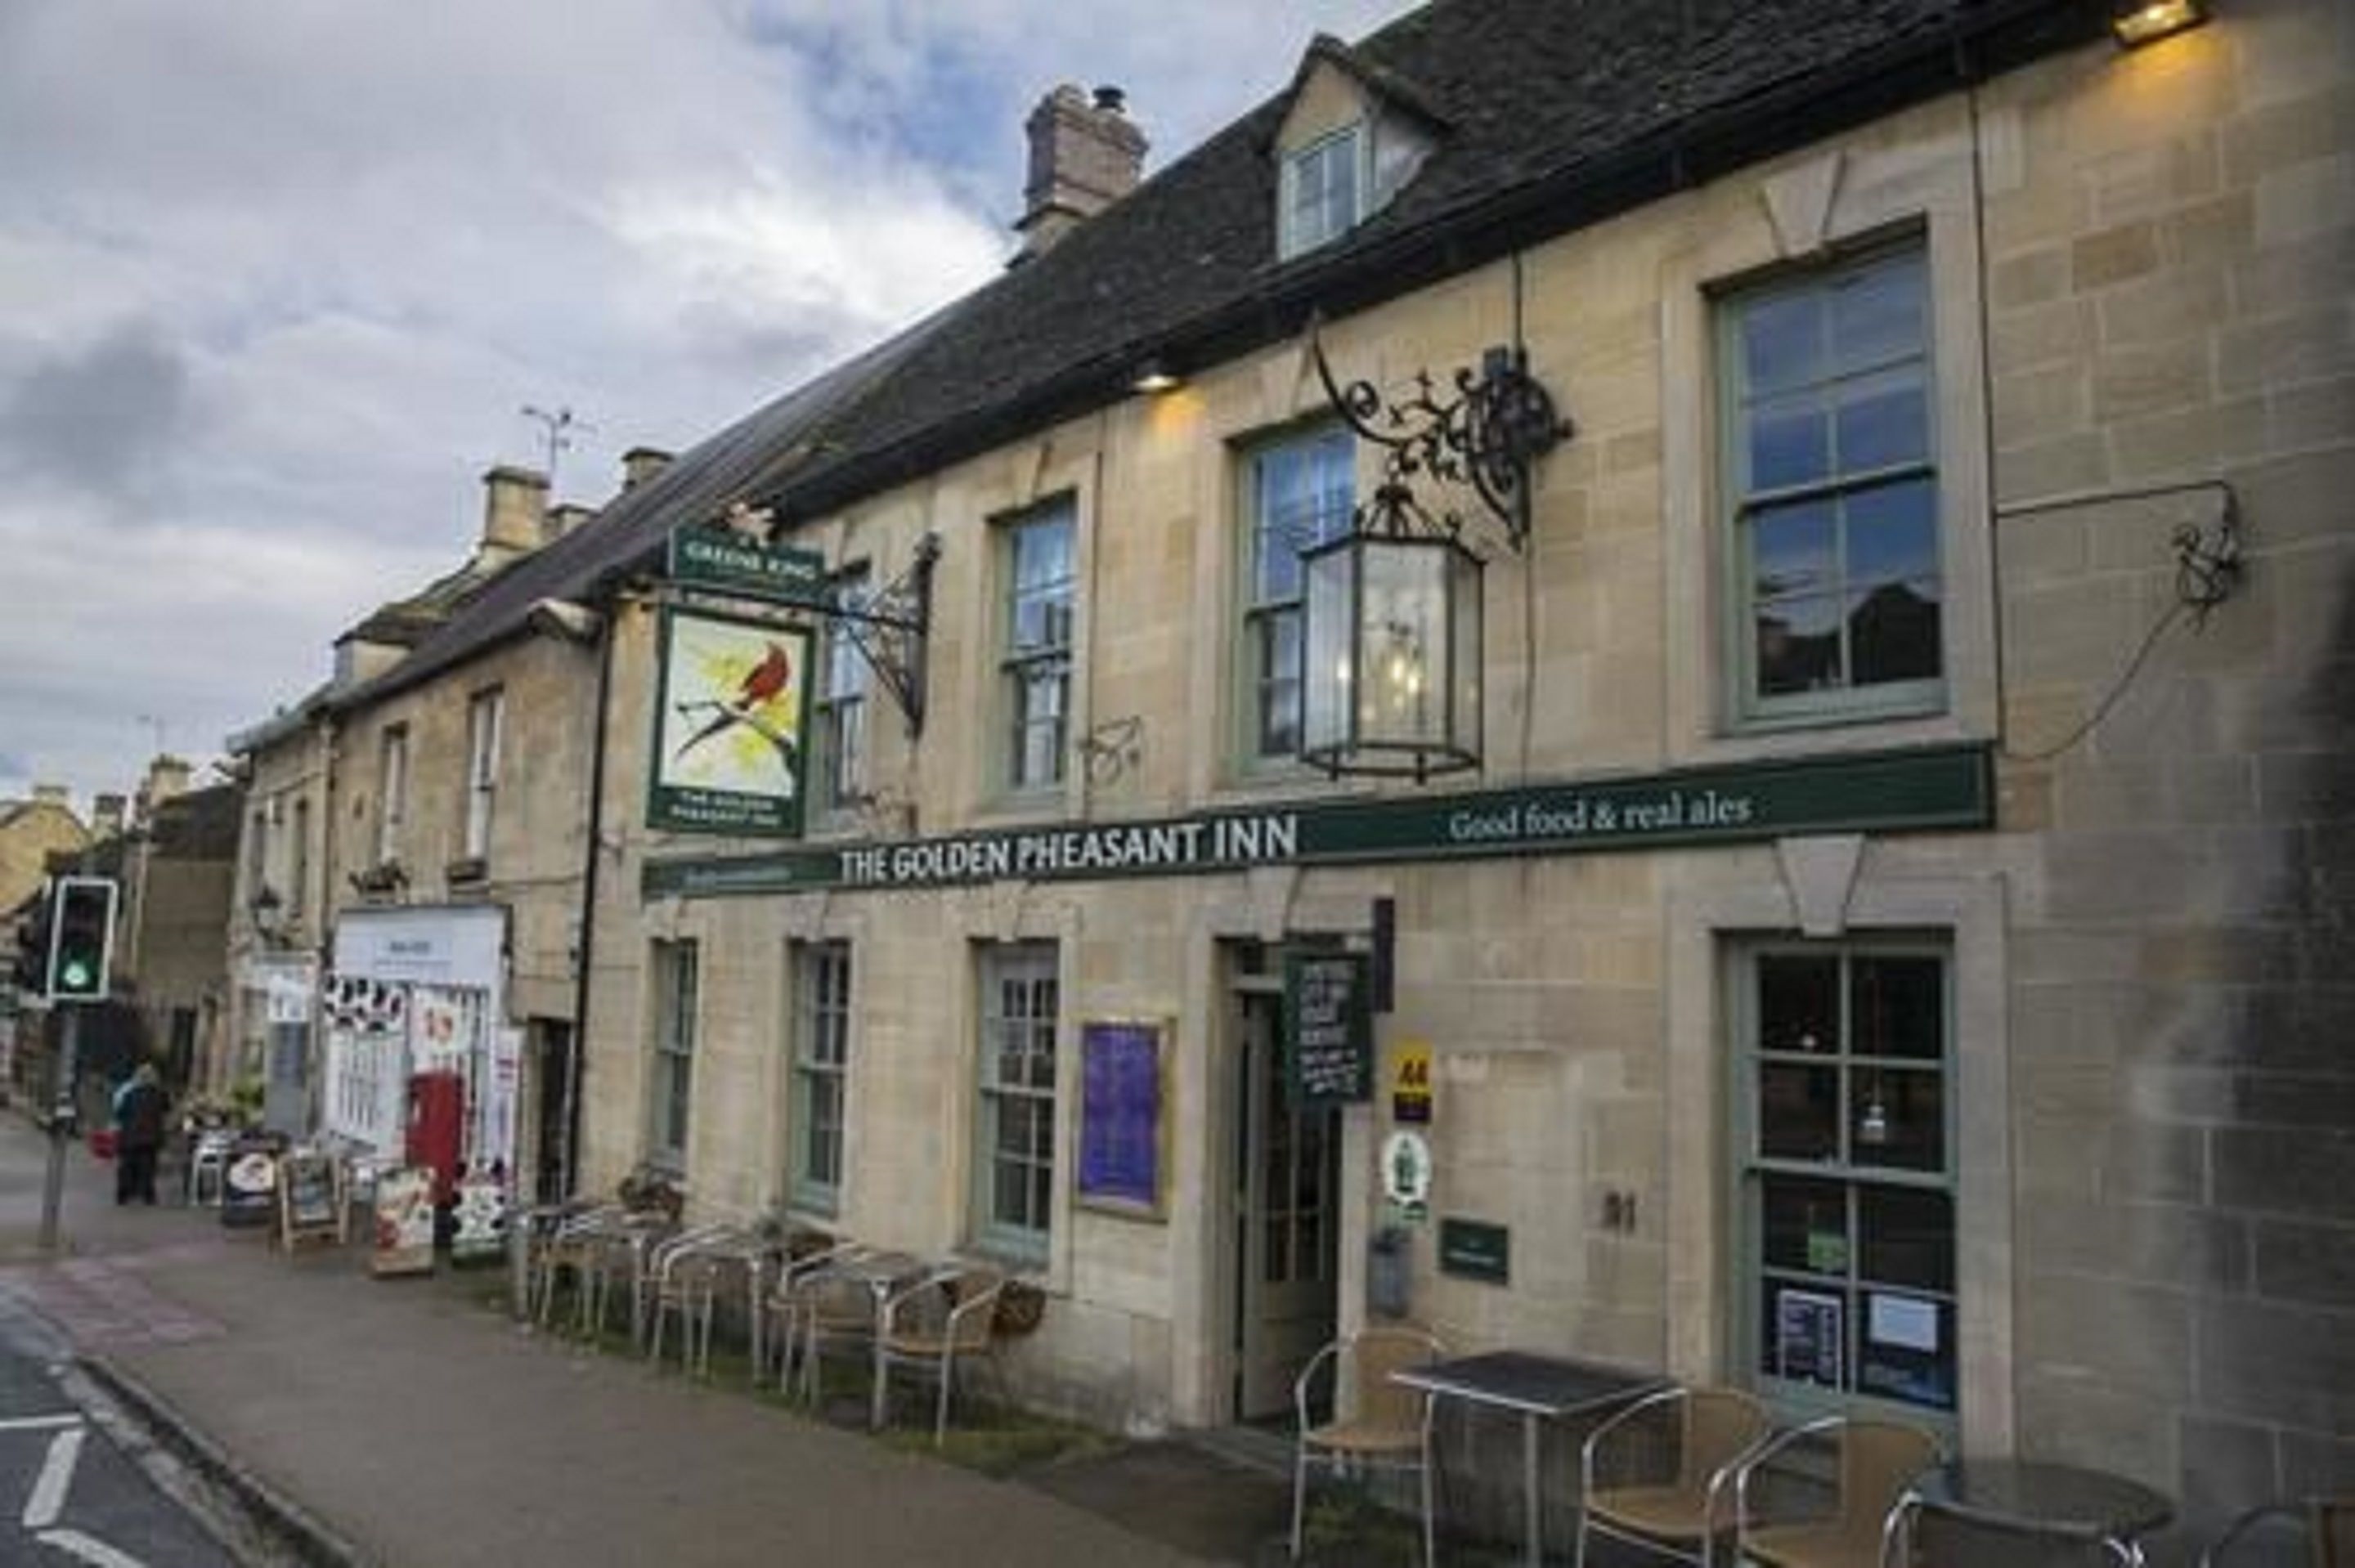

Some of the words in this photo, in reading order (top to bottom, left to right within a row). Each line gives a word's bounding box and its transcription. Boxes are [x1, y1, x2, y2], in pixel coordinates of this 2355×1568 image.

[1449, 807, 1518, 840] Good
[1524, 799, 1587, 836] food
[1595, 799, 1617, 831] &
[1623, 790, 1683, 830] real
[1689, 789, 1755, 826] ales
[841, 847, 887, 884] THE
[894, 839, 1010, 880] GOLDEN
[1016, 822, 1206, 871] PHEASANT
[1213, 813, 1298, 859] INN
